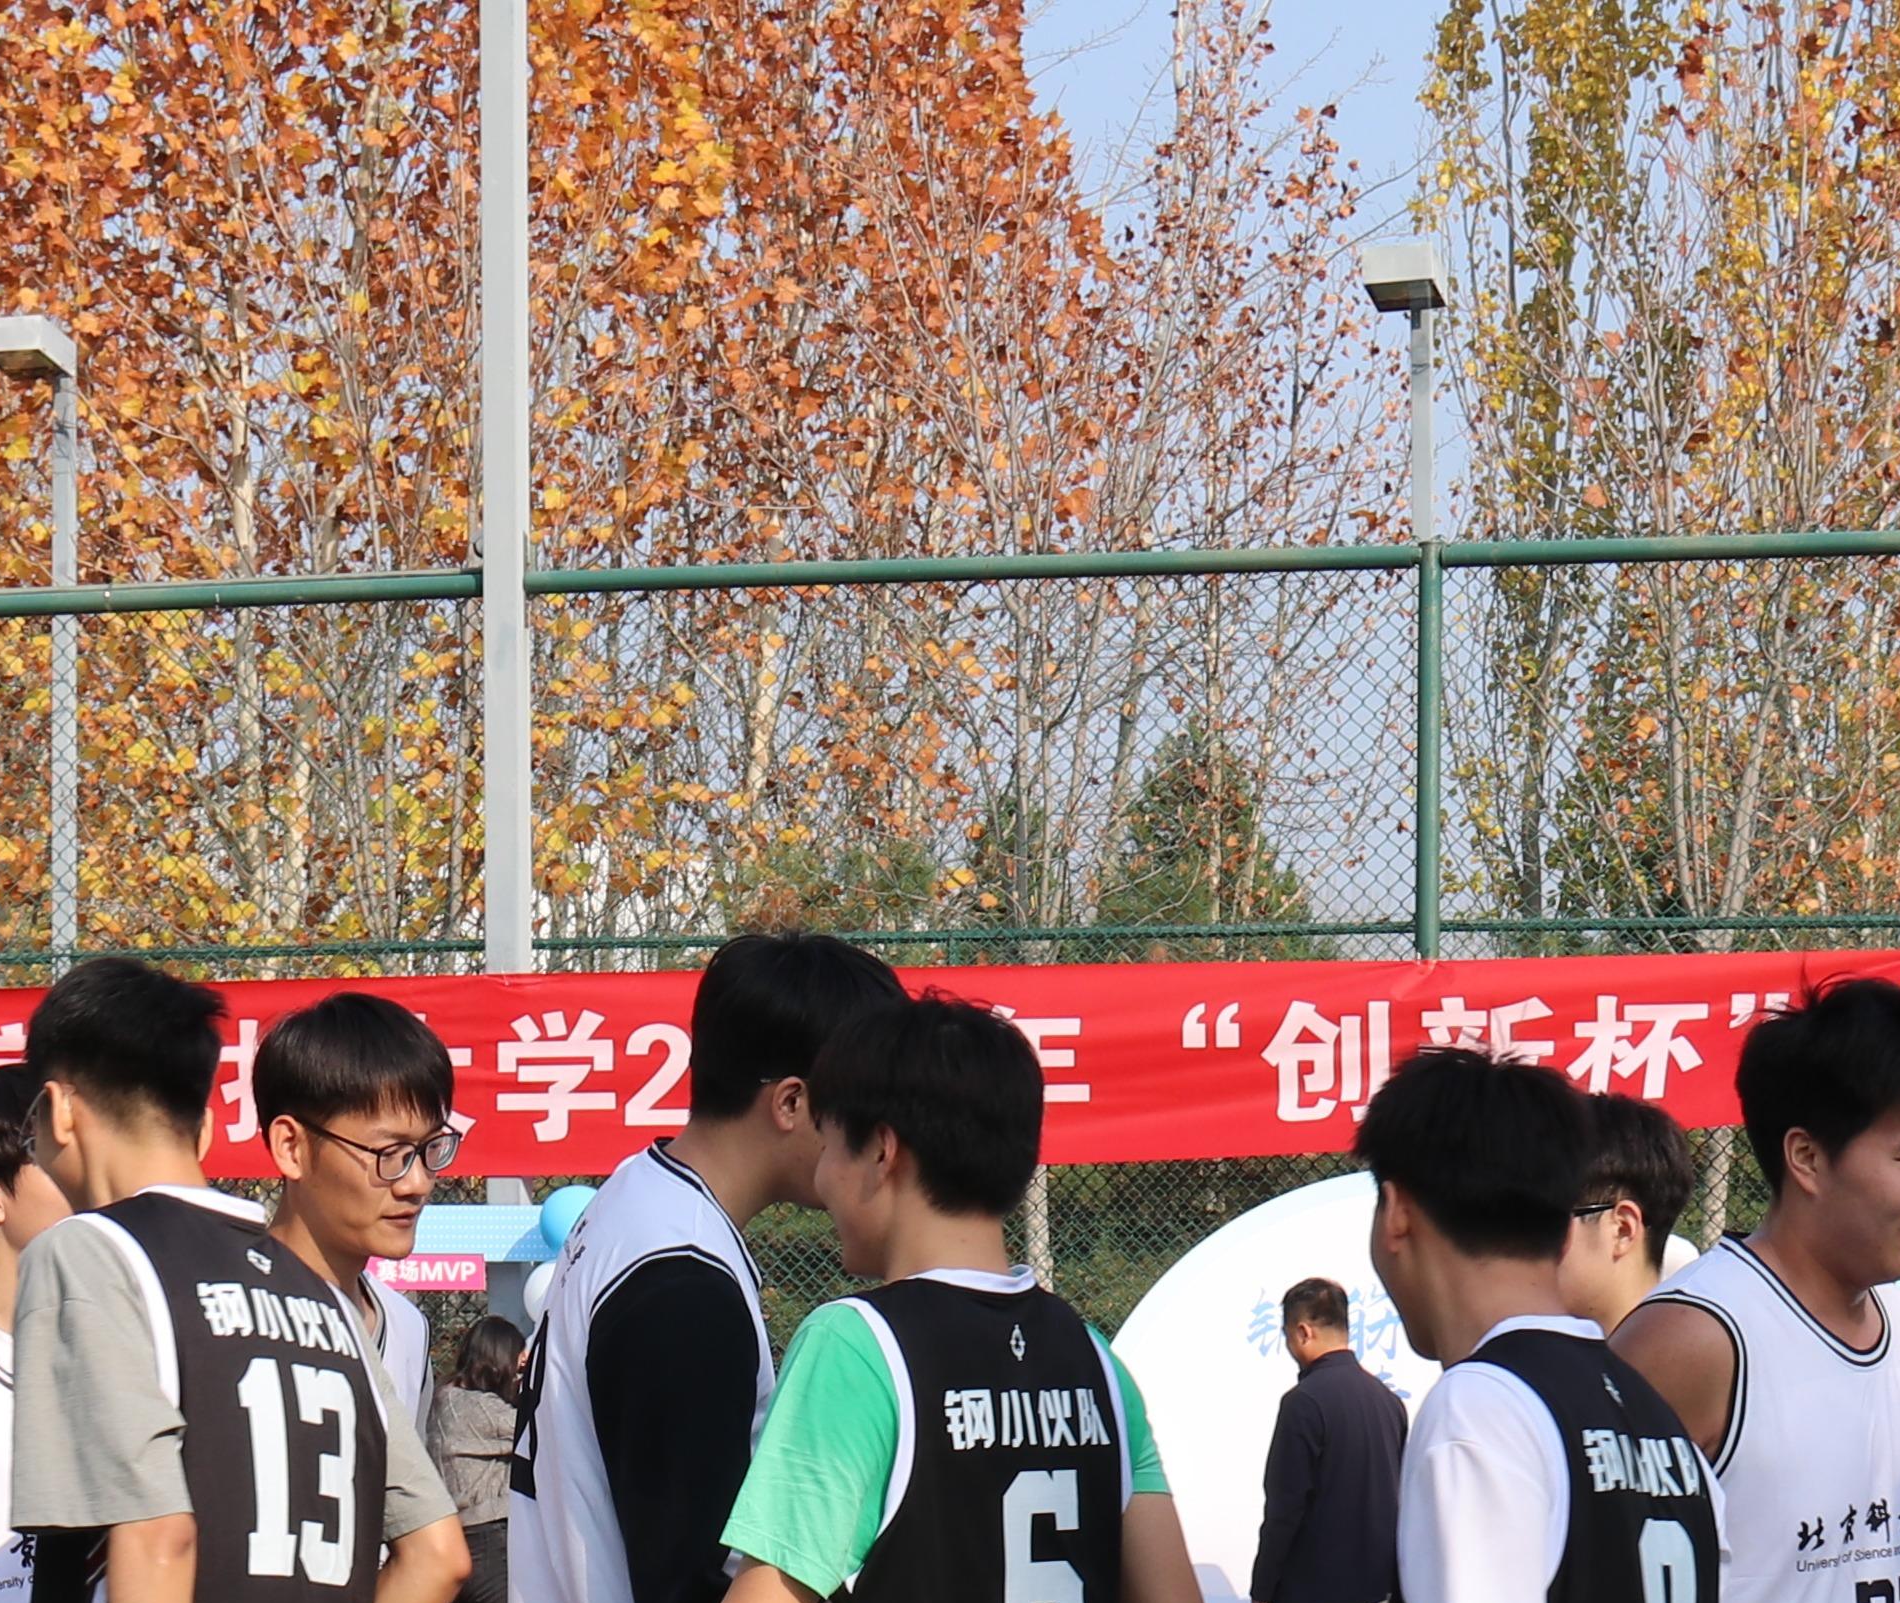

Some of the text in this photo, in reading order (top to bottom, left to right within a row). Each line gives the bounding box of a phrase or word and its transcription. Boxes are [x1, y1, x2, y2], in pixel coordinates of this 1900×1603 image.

[376, 1258, 477, 1284] 赛场MVP
[196, 1282, 360, 1360] 钢小伙队
[944, 1388, 1110, 1450] 钢小伙队
[237, 1357, 358, 1587] 13
